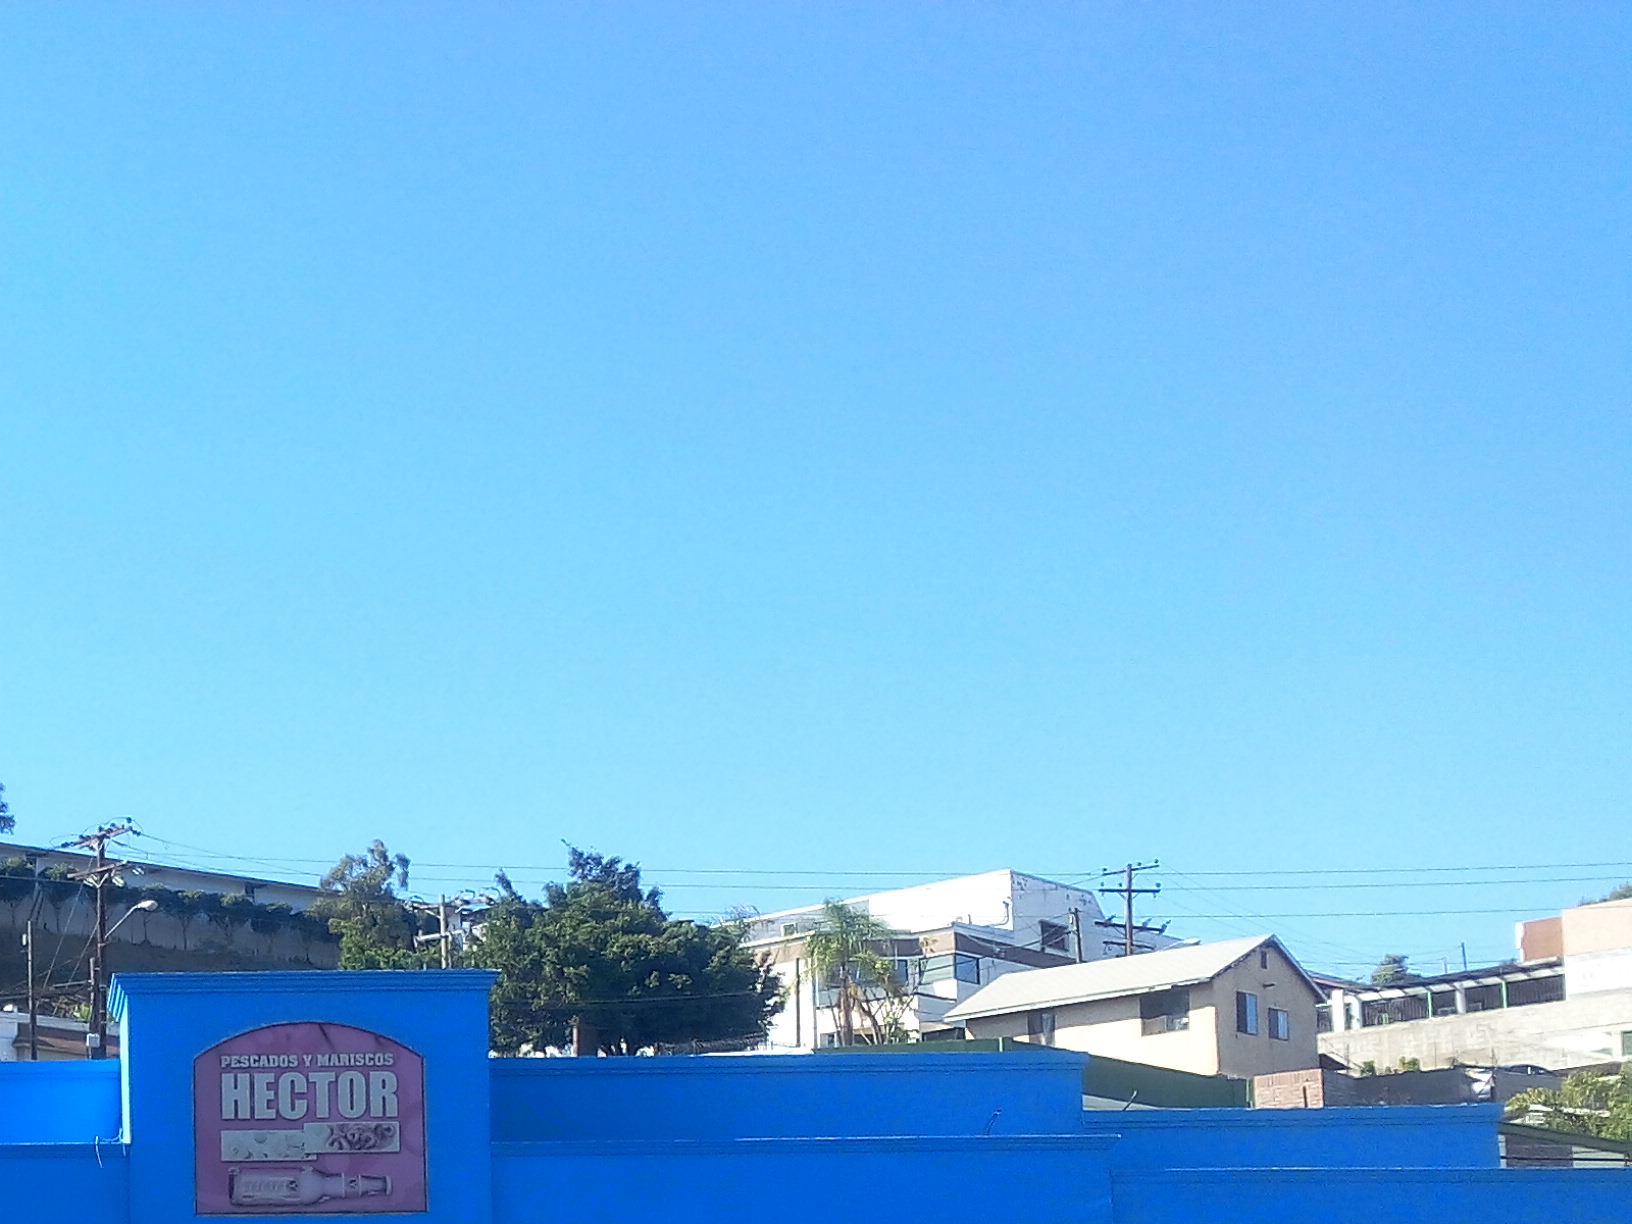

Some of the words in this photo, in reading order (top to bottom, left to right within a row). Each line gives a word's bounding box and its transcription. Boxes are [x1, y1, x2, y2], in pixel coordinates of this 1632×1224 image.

[221, 1054, 298, 1068] PESCADOS
[302, 1054, 312, 1067] Y
[317, 1053, 394, 1067] MARISCOS
[221, 1070, 398, 1120] HECTOR
